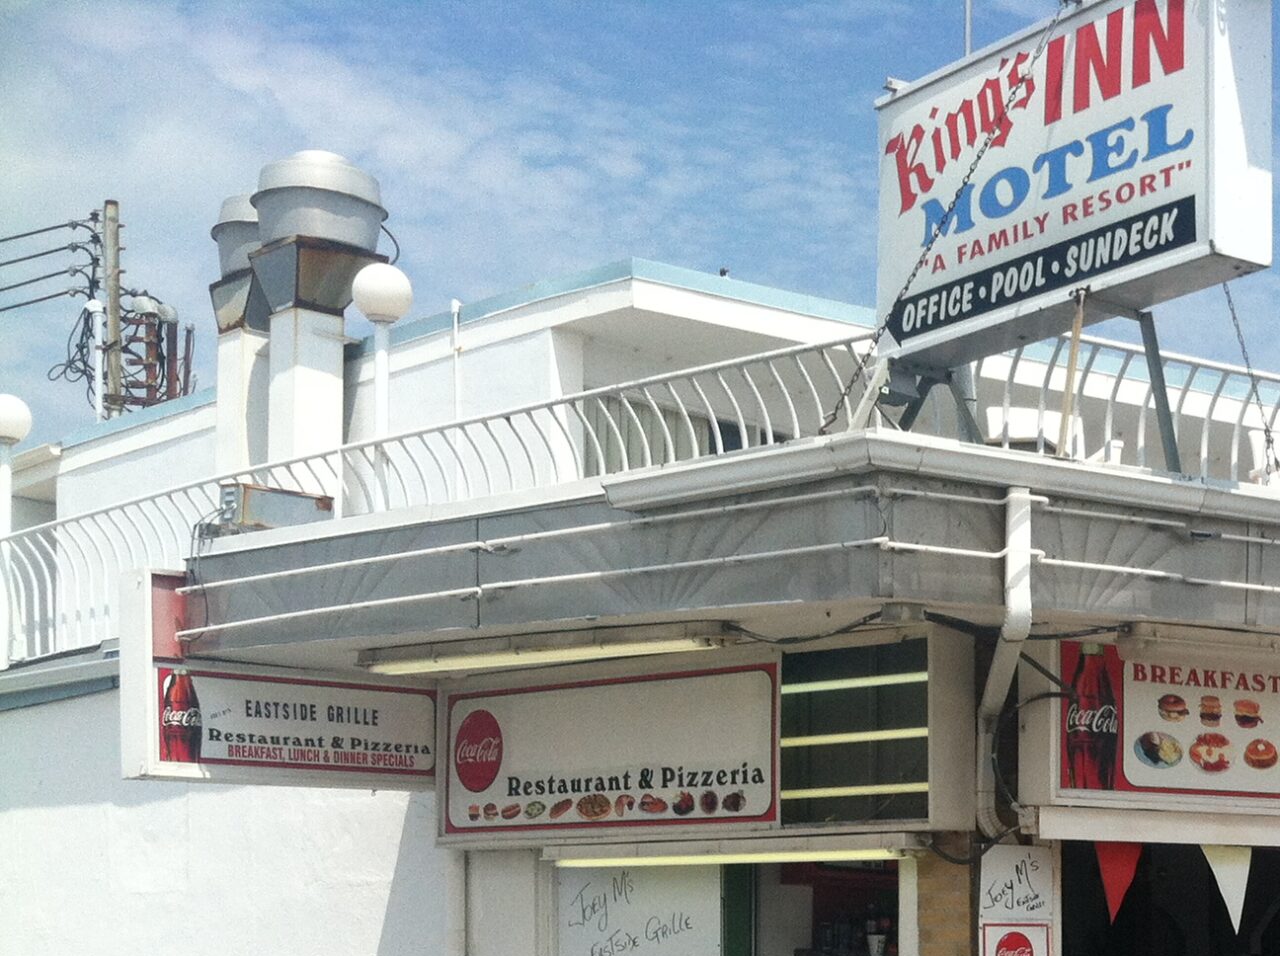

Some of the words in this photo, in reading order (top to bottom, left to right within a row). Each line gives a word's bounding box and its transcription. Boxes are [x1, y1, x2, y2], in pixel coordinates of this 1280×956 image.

[885, 52, 1037, 219] King's
[1044, 0, 1185, 126] INN
[921, 103, 1194, 248] MOTEL
[957, 210, 1050, 263] FAMILY
[901, 280, 973, 333] OFFICE
[991, 258, 1047, 304] POOL
[1064, 207, 1178, 280] SUNDECK
[245, 699, 317, 722] EASTSIDE
[327, 705, 380, 726] GRILLE
[208, 727, 326, 749] Restaurant
[331, 736, 345, 749] &
[350, 736, 432, 755] Pizzeria
[228, 744, 286, 762] BREAKFAST,
[288, 748, 321, 763] LUNCH
[324, 750, 331, 763] &
[334, 750, 369, 766] DINNER
[371, 754, 415, 768] SPECIALS
[507, 770, 632, 797] Restaurant
[638, 768, 655, 789] &
[661, 762, 765, 788] Pizzeria
